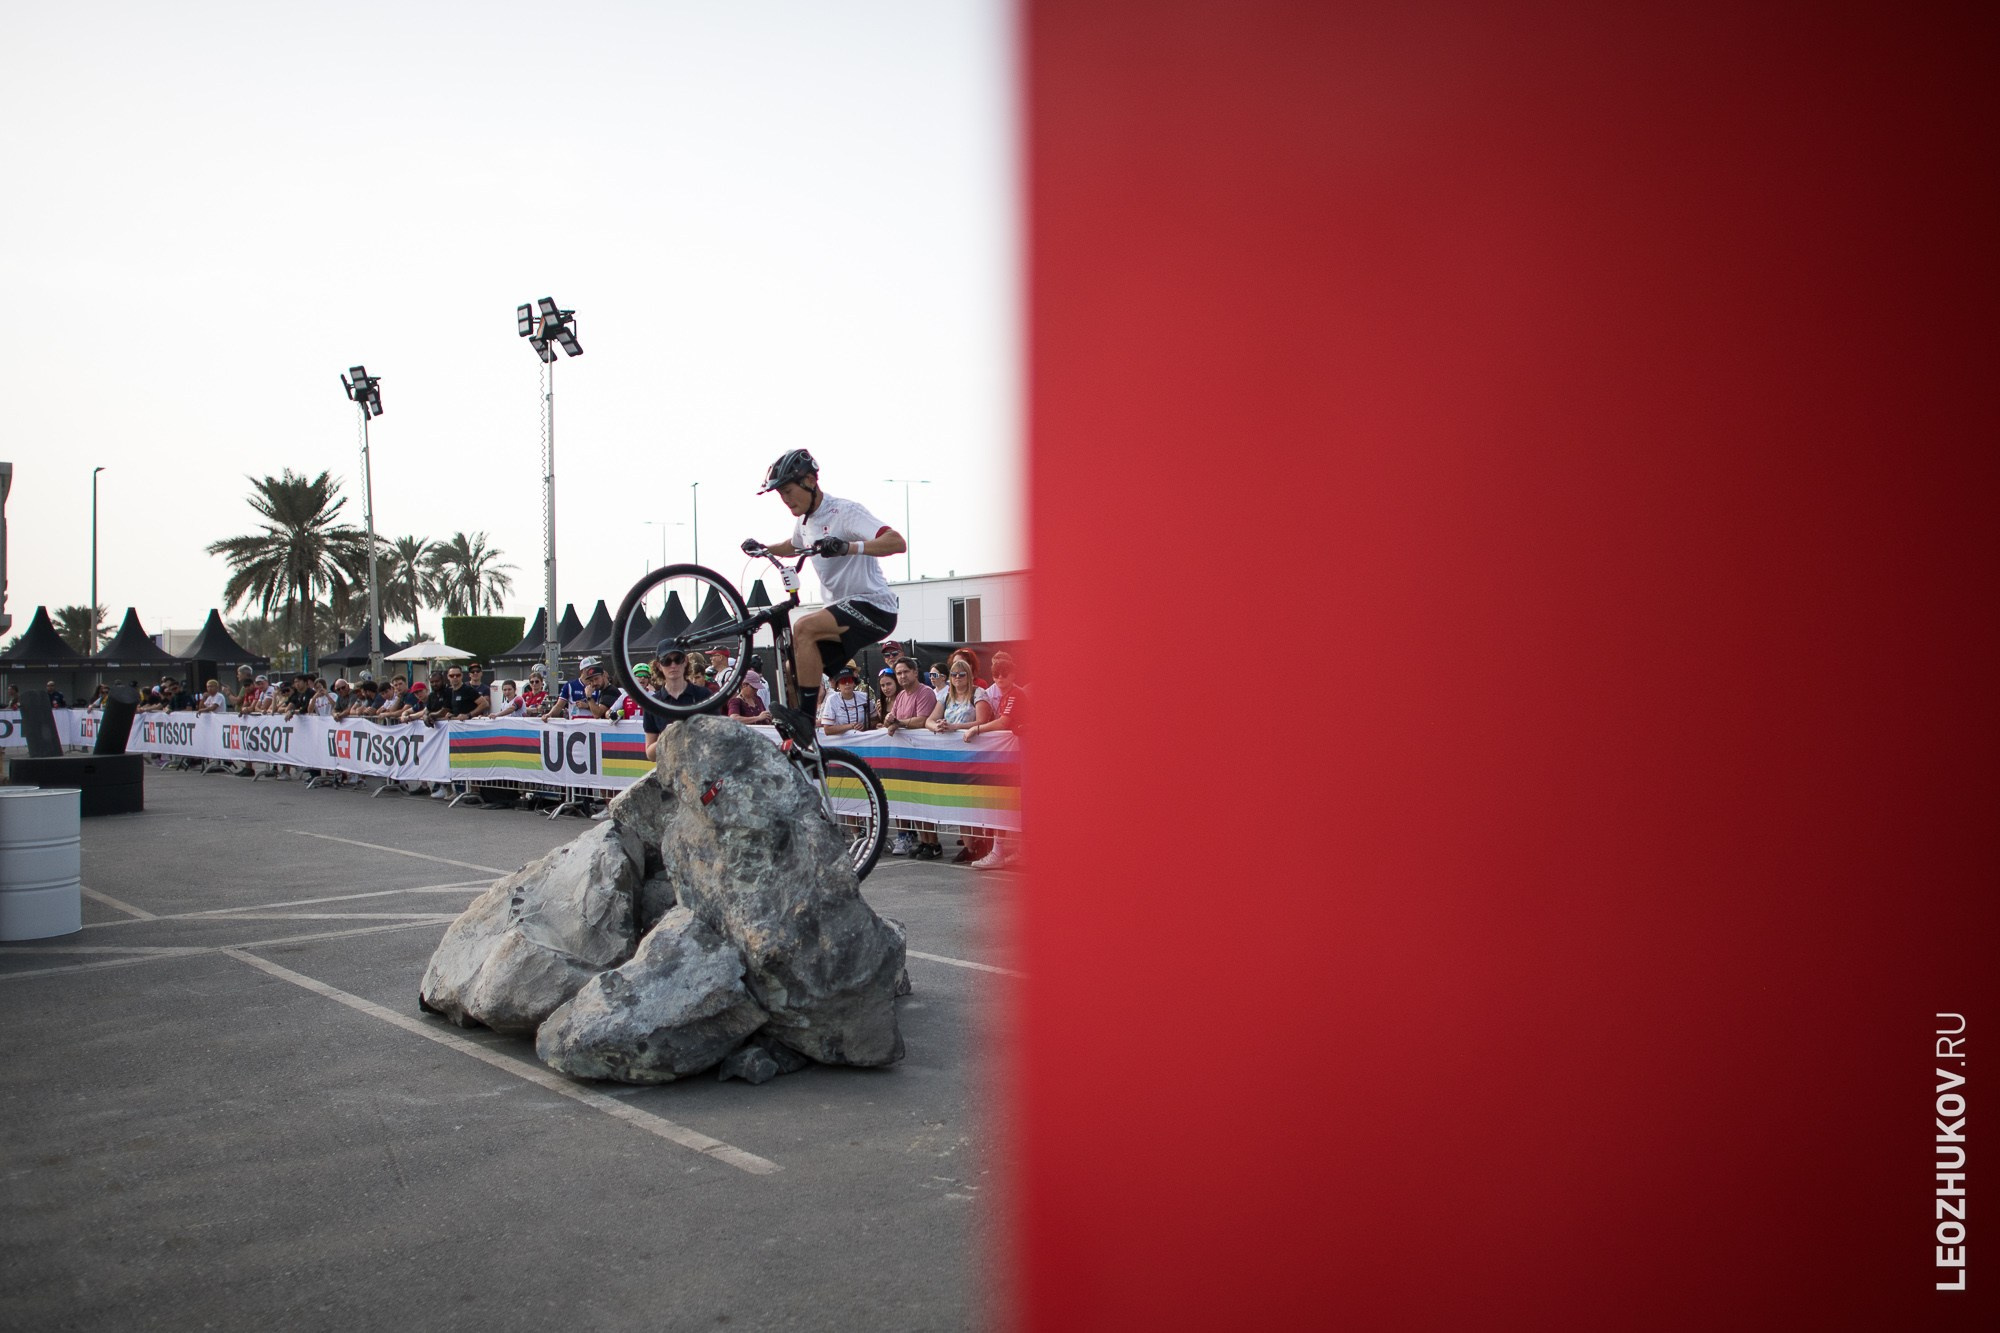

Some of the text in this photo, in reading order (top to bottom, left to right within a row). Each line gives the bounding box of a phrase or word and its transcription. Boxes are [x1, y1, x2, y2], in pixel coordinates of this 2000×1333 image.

[155, 721, 196, 746] TISSOT
[240, 725, 294, 753] TISSOT
[353, 730, 424, 767] TISSOT
[543, 730, 598, 775] UCI
